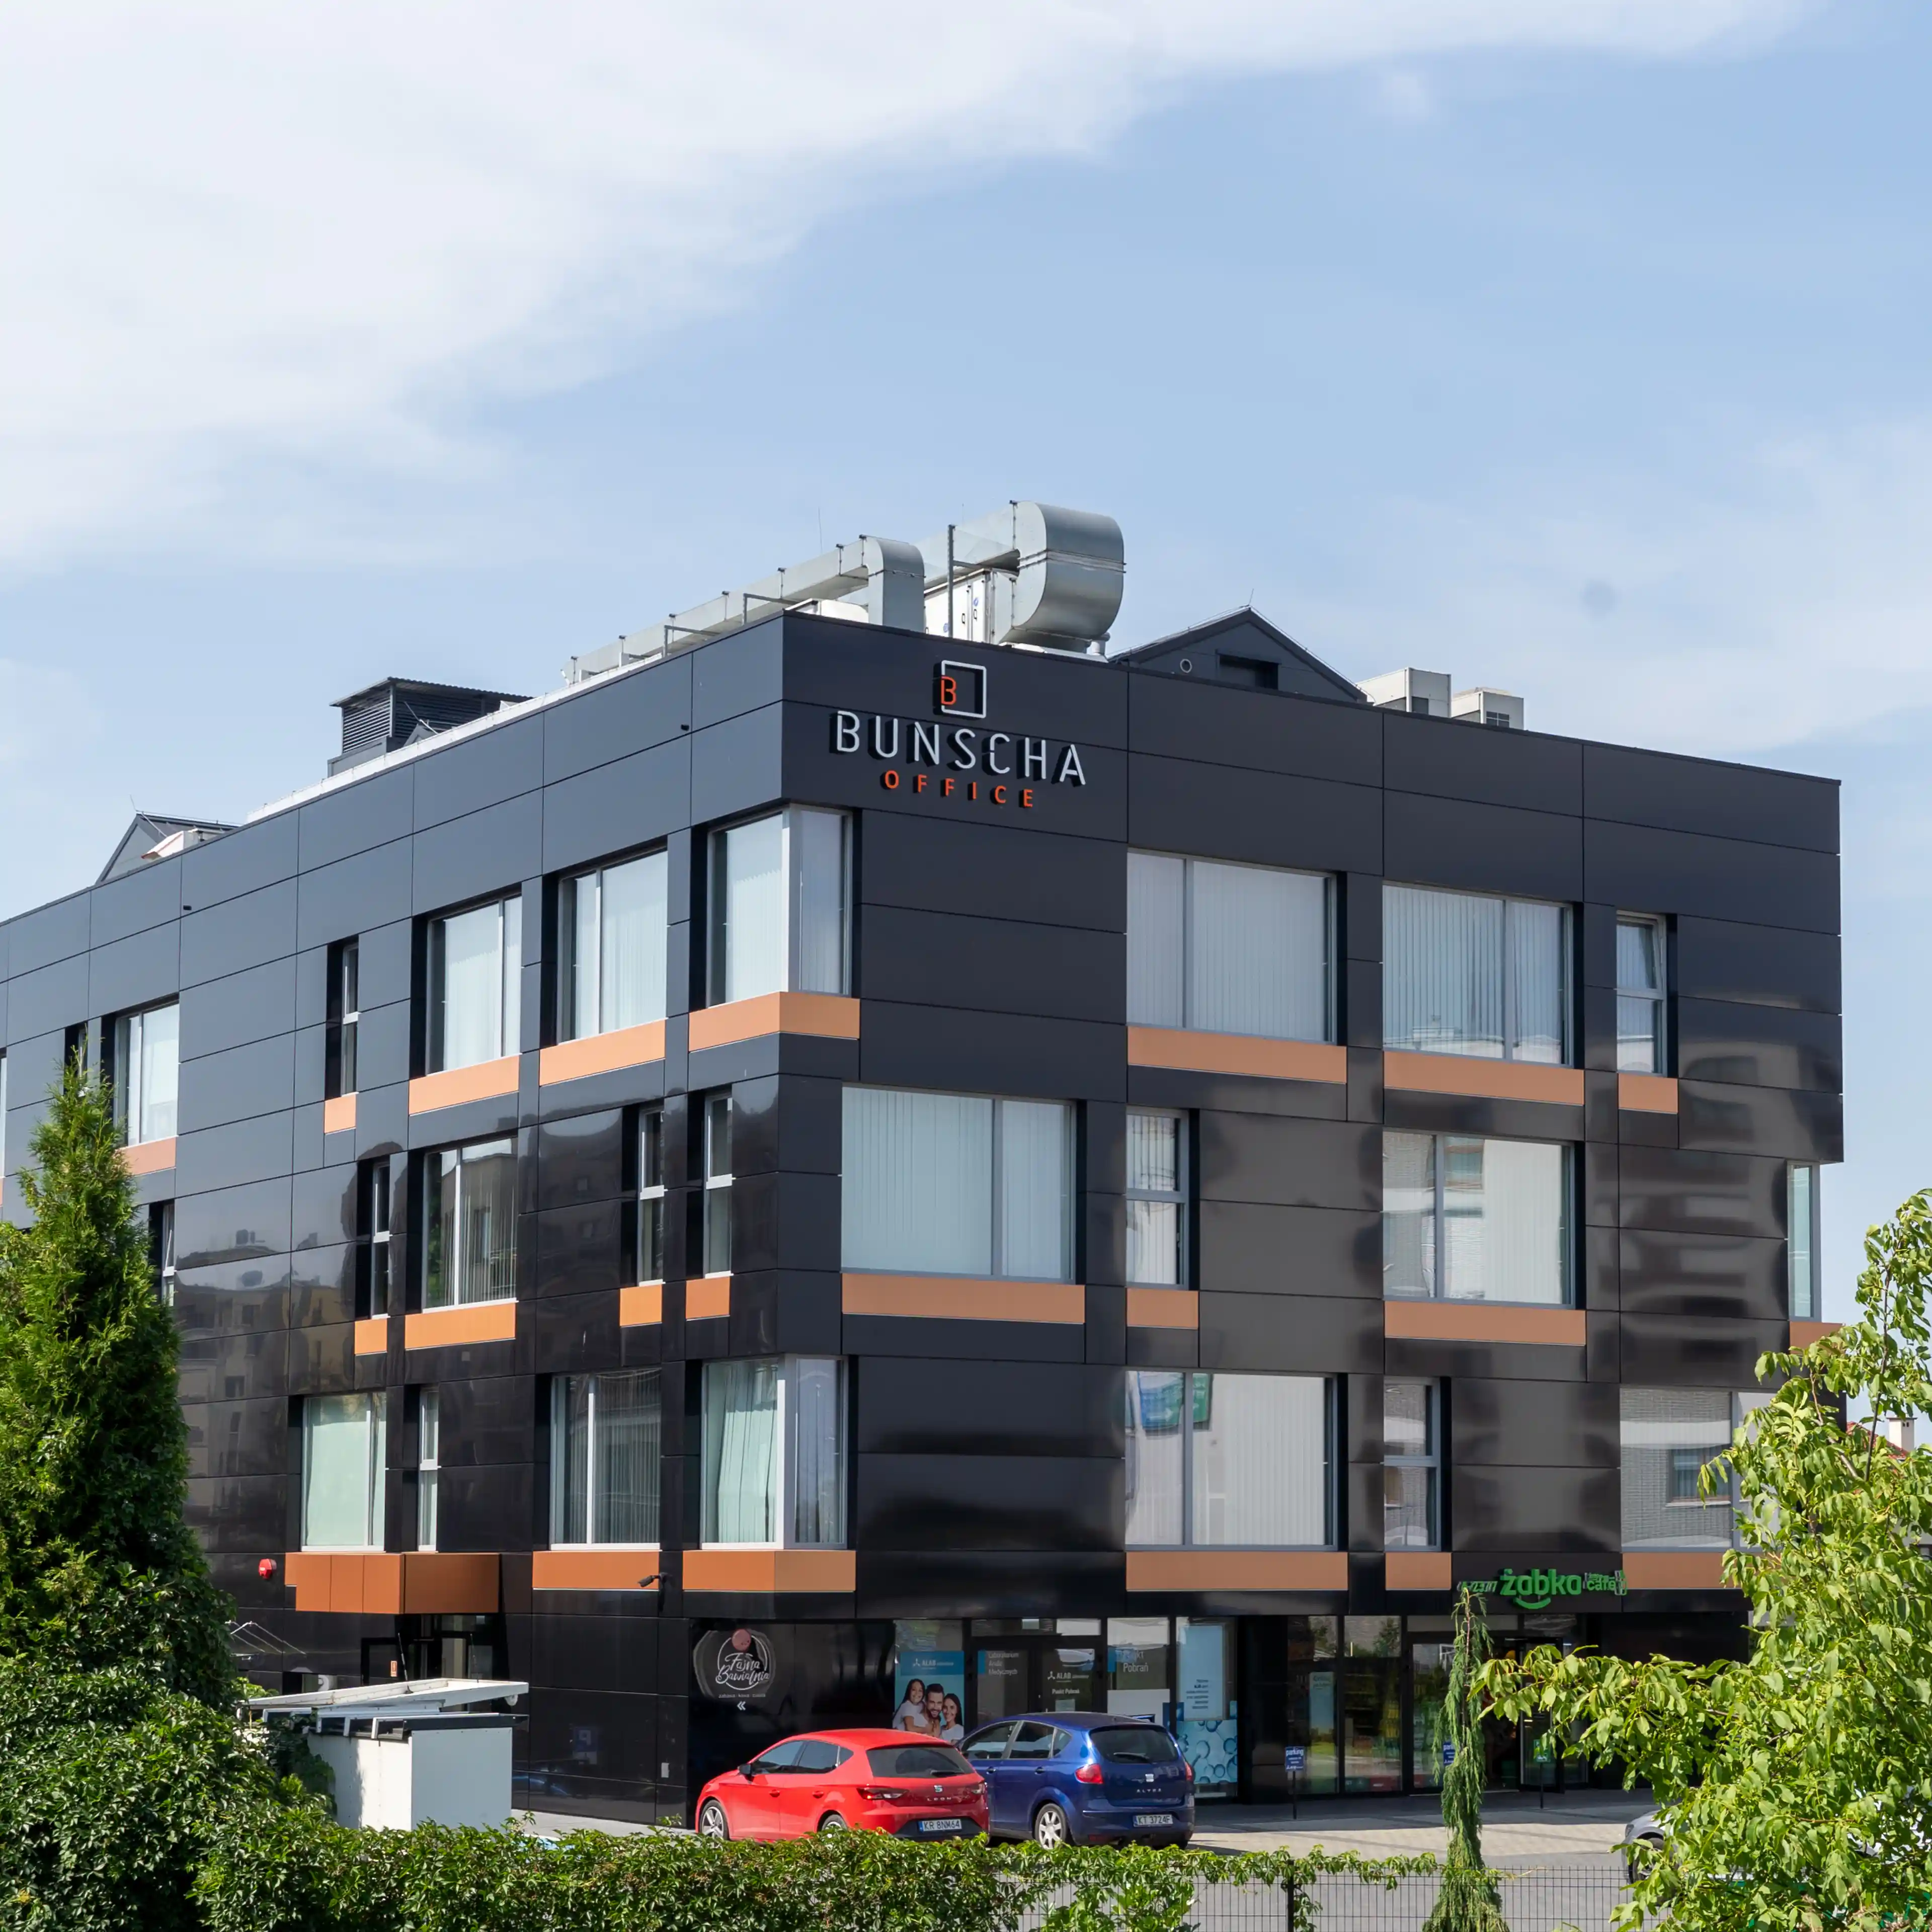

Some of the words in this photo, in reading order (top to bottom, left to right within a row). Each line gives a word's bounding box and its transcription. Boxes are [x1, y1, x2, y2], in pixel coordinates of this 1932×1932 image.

[940, 676, 957, 705] B
[836, 710, 1086, 785] BUNSCHA
[884, 770, 1033, 808] OFFICE
[1500, 1568, 1581, 1595] żabka
[725, 1652, 760, 1671] Fajna
[715, 1664, 770, 1685] Bawialnia
[923, 1821, 935, 1829] KR
[937, 1820, 960, 1828] 8NM64
[1138, 1816, 1147, 1824] KT
